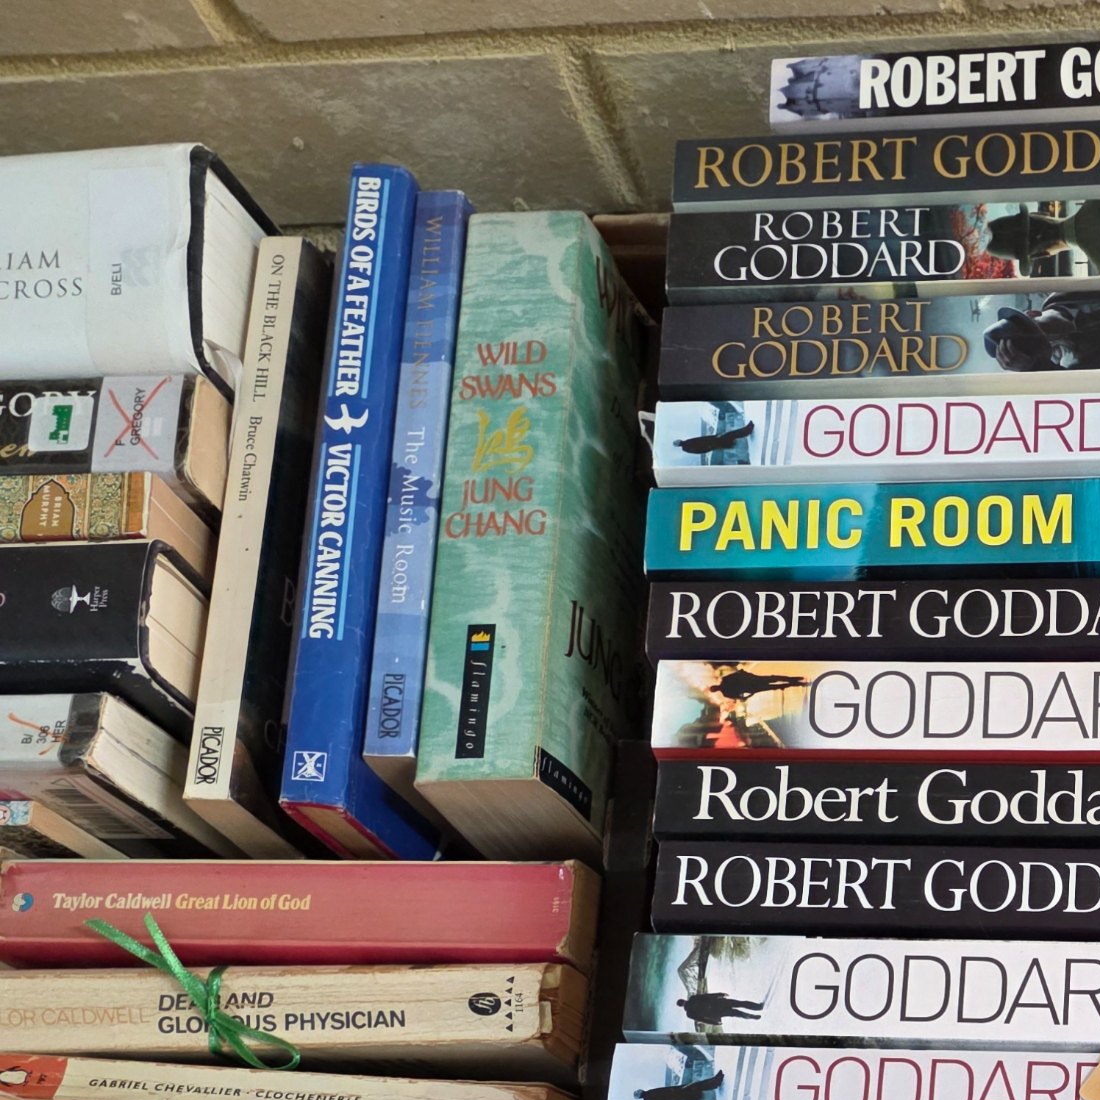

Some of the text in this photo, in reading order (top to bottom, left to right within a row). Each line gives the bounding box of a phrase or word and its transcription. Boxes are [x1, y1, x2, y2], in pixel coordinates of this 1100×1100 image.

[859, 50, 1046, 109] ROBERT
[694, 136, 918, 189] ROBERT
[336, 176, 381, 397] BIRDS OF A FEATHER
[252, 254, 285, 403] ON THE BLACK HILL
[477, 340, 548, 367] WILD
[459, 372, 556, 400] SWANS
[130, 387, 147, 446] GREGORY
[238, 416, 264, 502] Bruce Chatwin
[390, 427, 425, 604] The Music Room
[461, 476, 535, 512] JUNG
[679, 492, 1073, 552] PANIC ROOM
[309, 442, 352, 640] VICTOR CANNING
[445, 509, 547, 539] CHANG
[665, 588, 896, 640] ROBERT
[378, 673, 406, 740] PICADOR
[194, 726, 224, 785] PICADOR
[53, 892, 311, 911] Taylor Caldwell Great Lion of God
[89, 1079, 155, 1091] GABRIEL
[154, 1083, 241, 1097] CHEVALLIER
